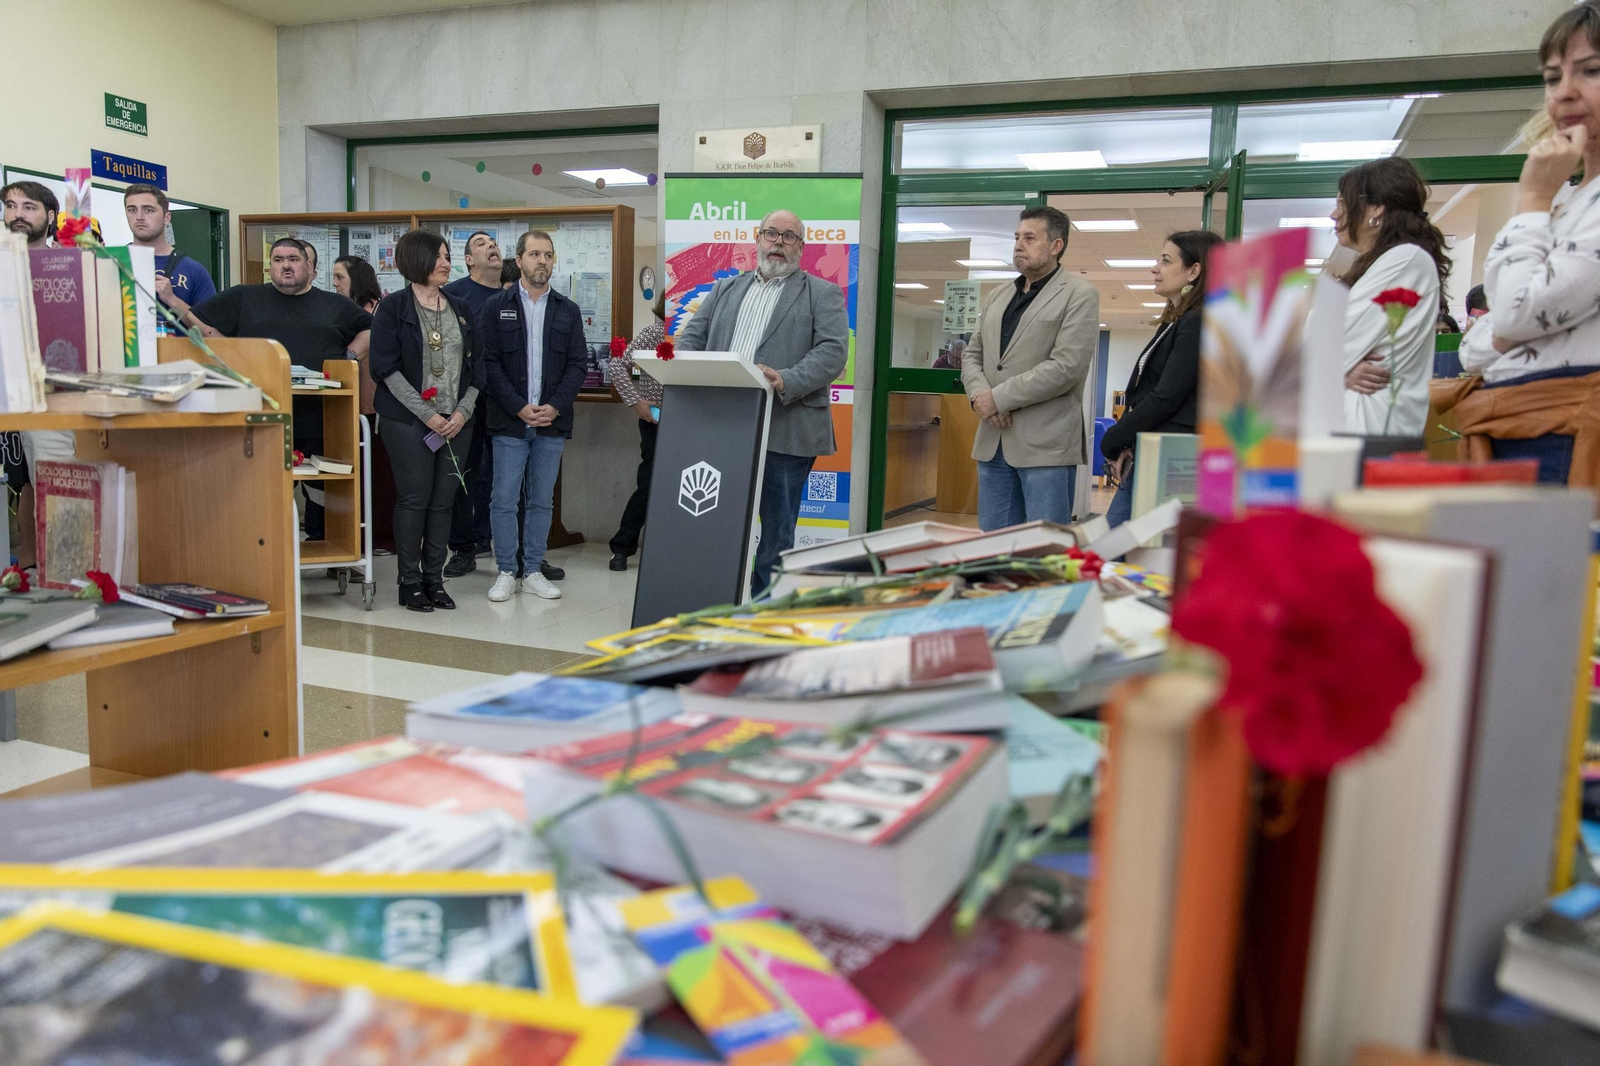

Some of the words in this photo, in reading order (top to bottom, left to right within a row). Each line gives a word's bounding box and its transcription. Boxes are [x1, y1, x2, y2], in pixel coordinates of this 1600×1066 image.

[115, 98, 137, 112] SALIDA
[122, 110, 131, 120] DE
[106, 115, 147, 134] EMERGENCIA
[103, 155, 157, 181] Taquillas
[747, 162, 764, 171] Felipe
[689, 200, 747, 221] Abril
[713, 230, 730, 240] en
[735, 228, 748, 240] la
[33, 277, 77, 292] STOLOGIA
[43, 290, 78, 303] BASICA
[53, 478, 92, 490] MOLECULAR
[799, 504, 826, 514] oteca/
